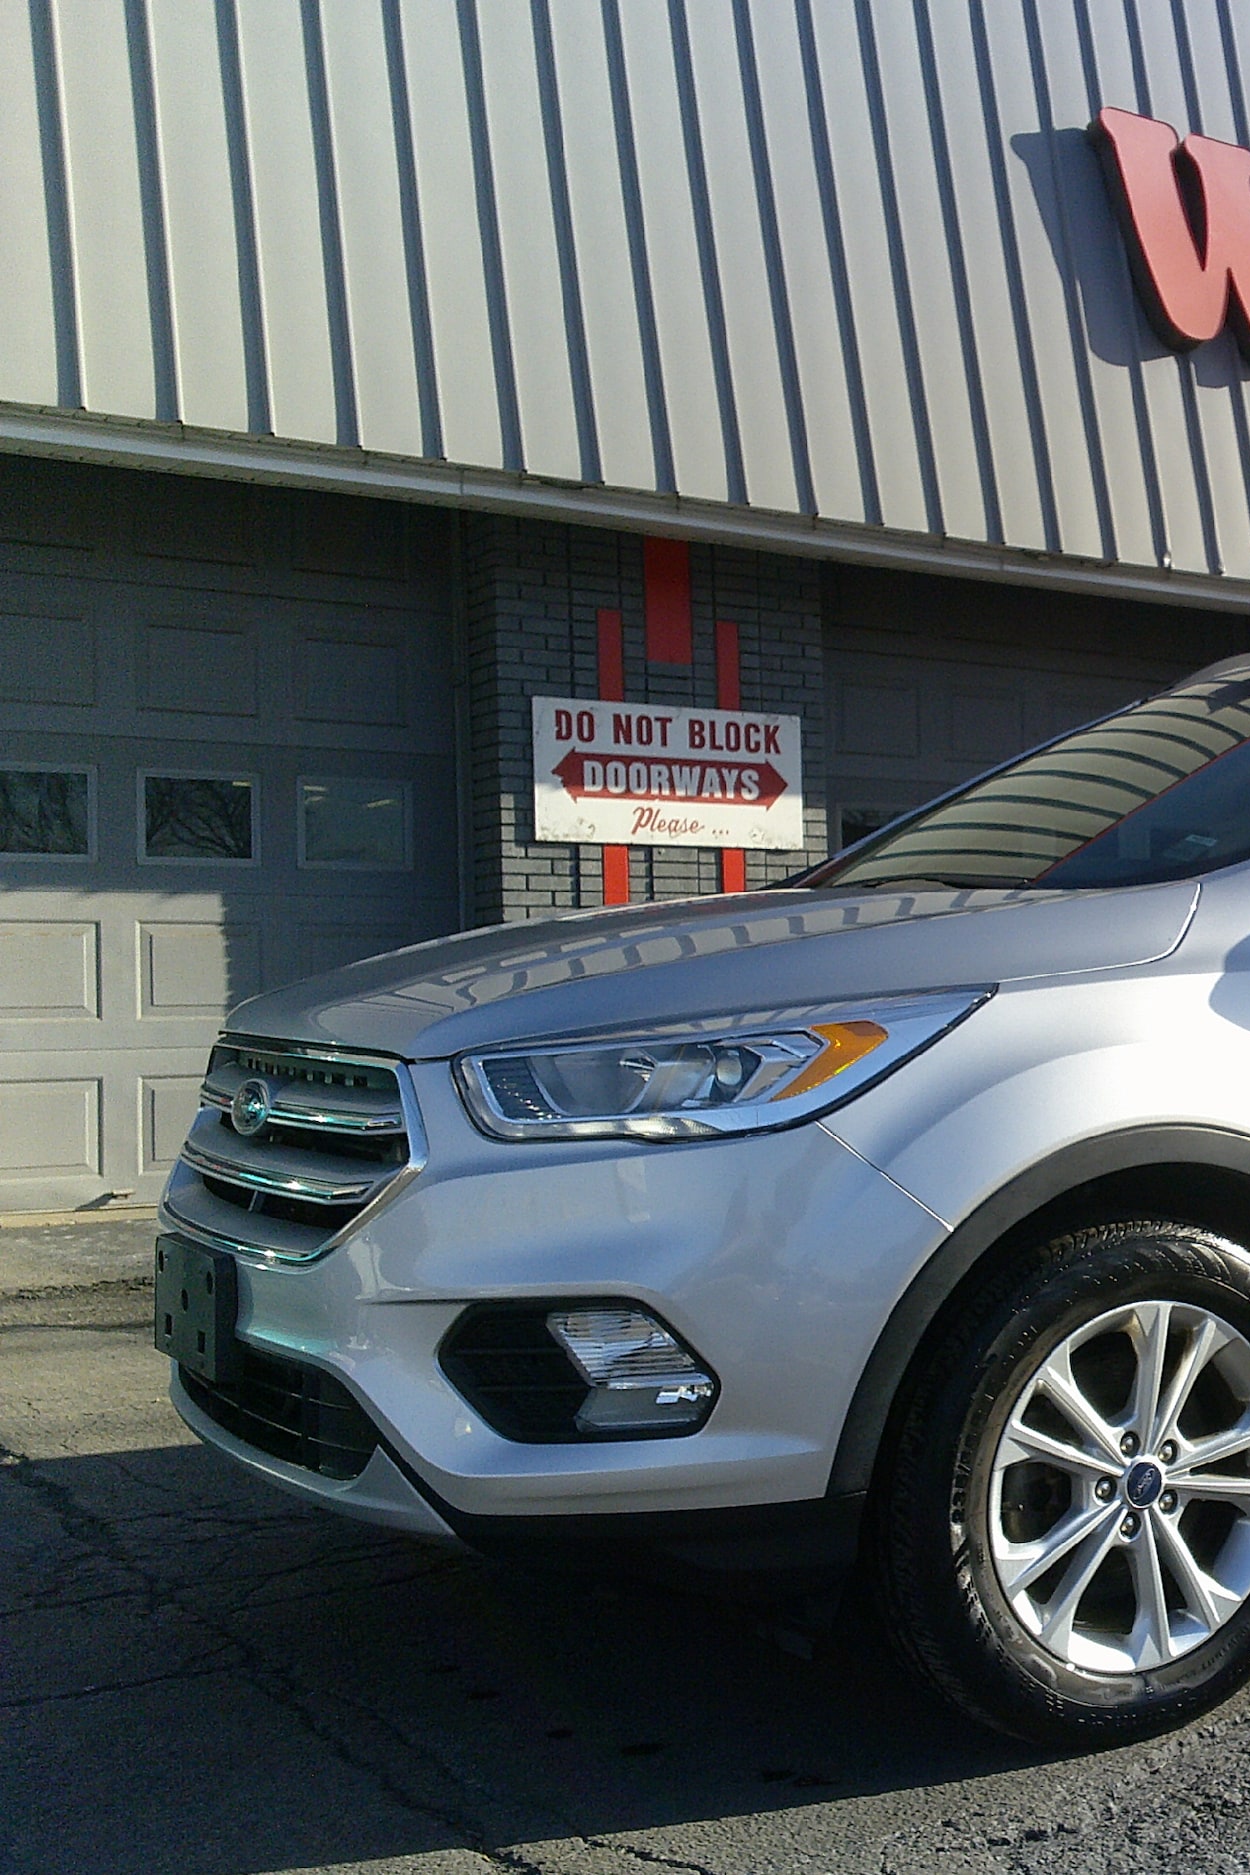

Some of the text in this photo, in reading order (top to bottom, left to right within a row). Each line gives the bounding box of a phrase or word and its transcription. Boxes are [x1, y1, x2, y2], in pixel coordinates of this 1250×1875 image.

[554, 709, 782, 754] DO NOT BLOCK
[582, 760, 760, 801] DOORWAYS
[631, 806, 705, 835] Please
